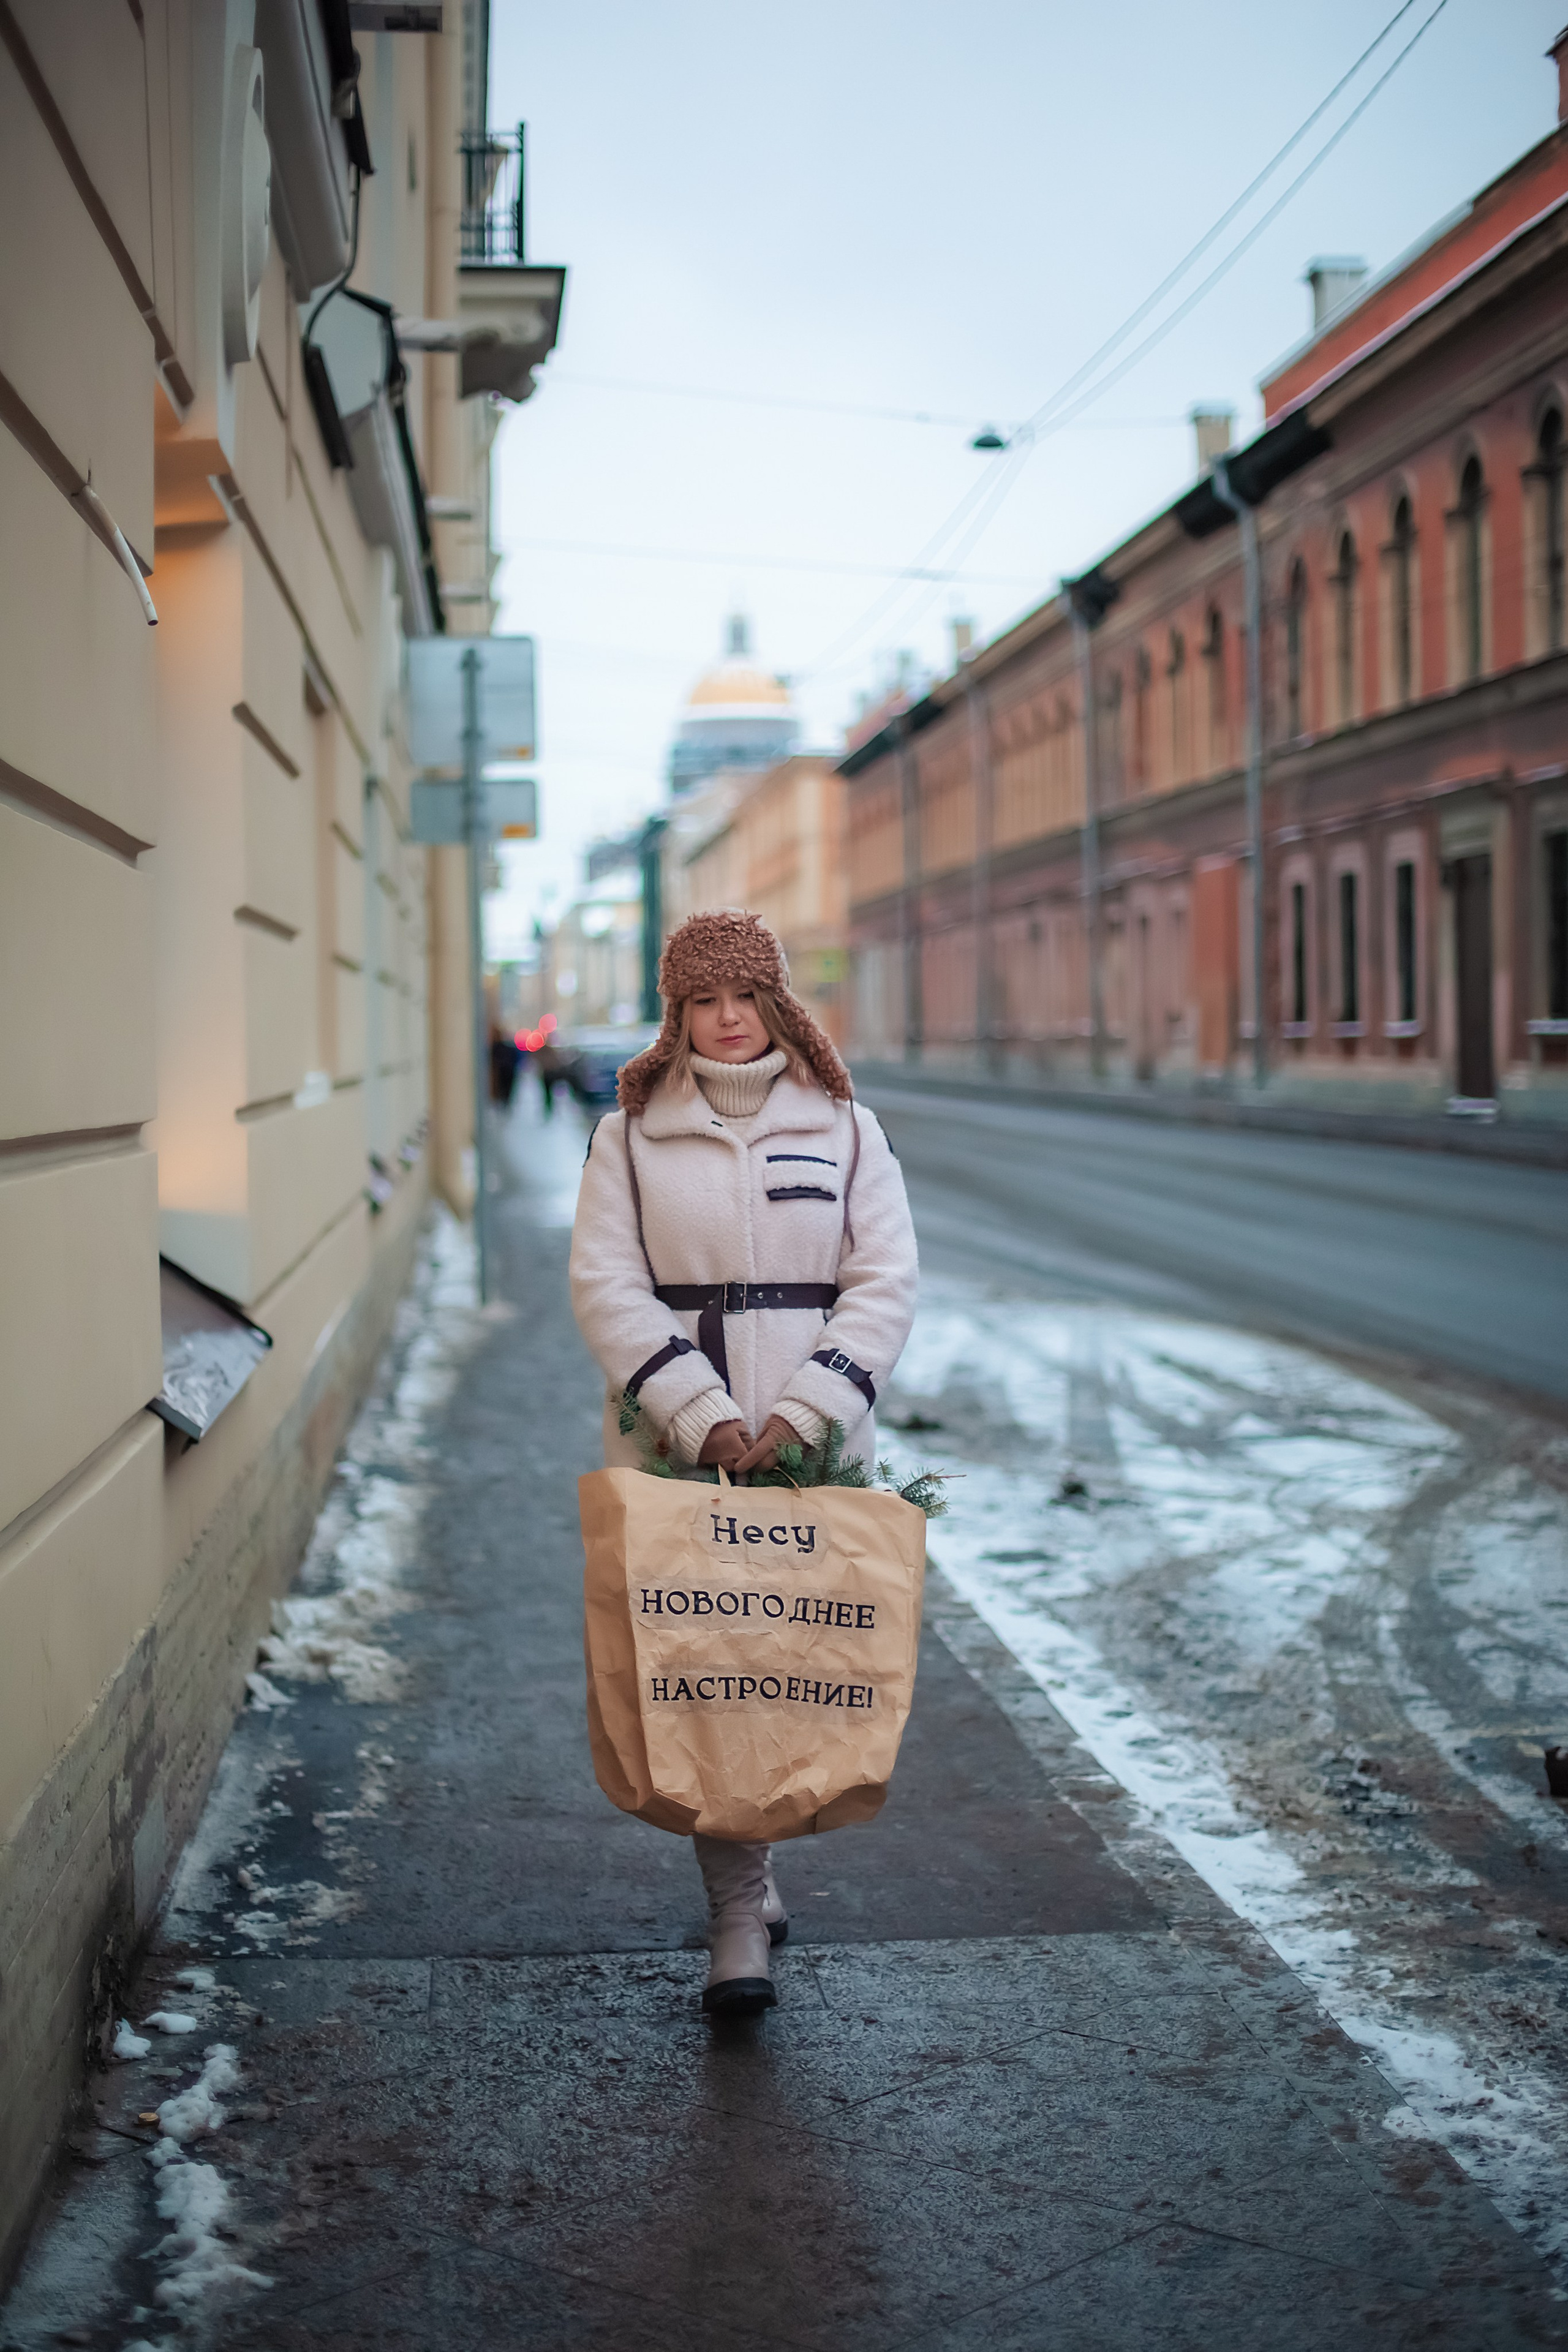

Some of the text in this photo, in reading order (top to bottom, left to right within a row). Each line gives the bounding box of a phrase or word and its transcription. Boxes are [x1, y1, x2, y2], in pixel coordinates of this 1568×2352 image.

[710, 1513, 816, 1554] Несу
[640, 1589, 876, 1630] НОВОГОДНЕЕ
[651, 1676, 873, 1709] НАСТРОЕНИЕ!
